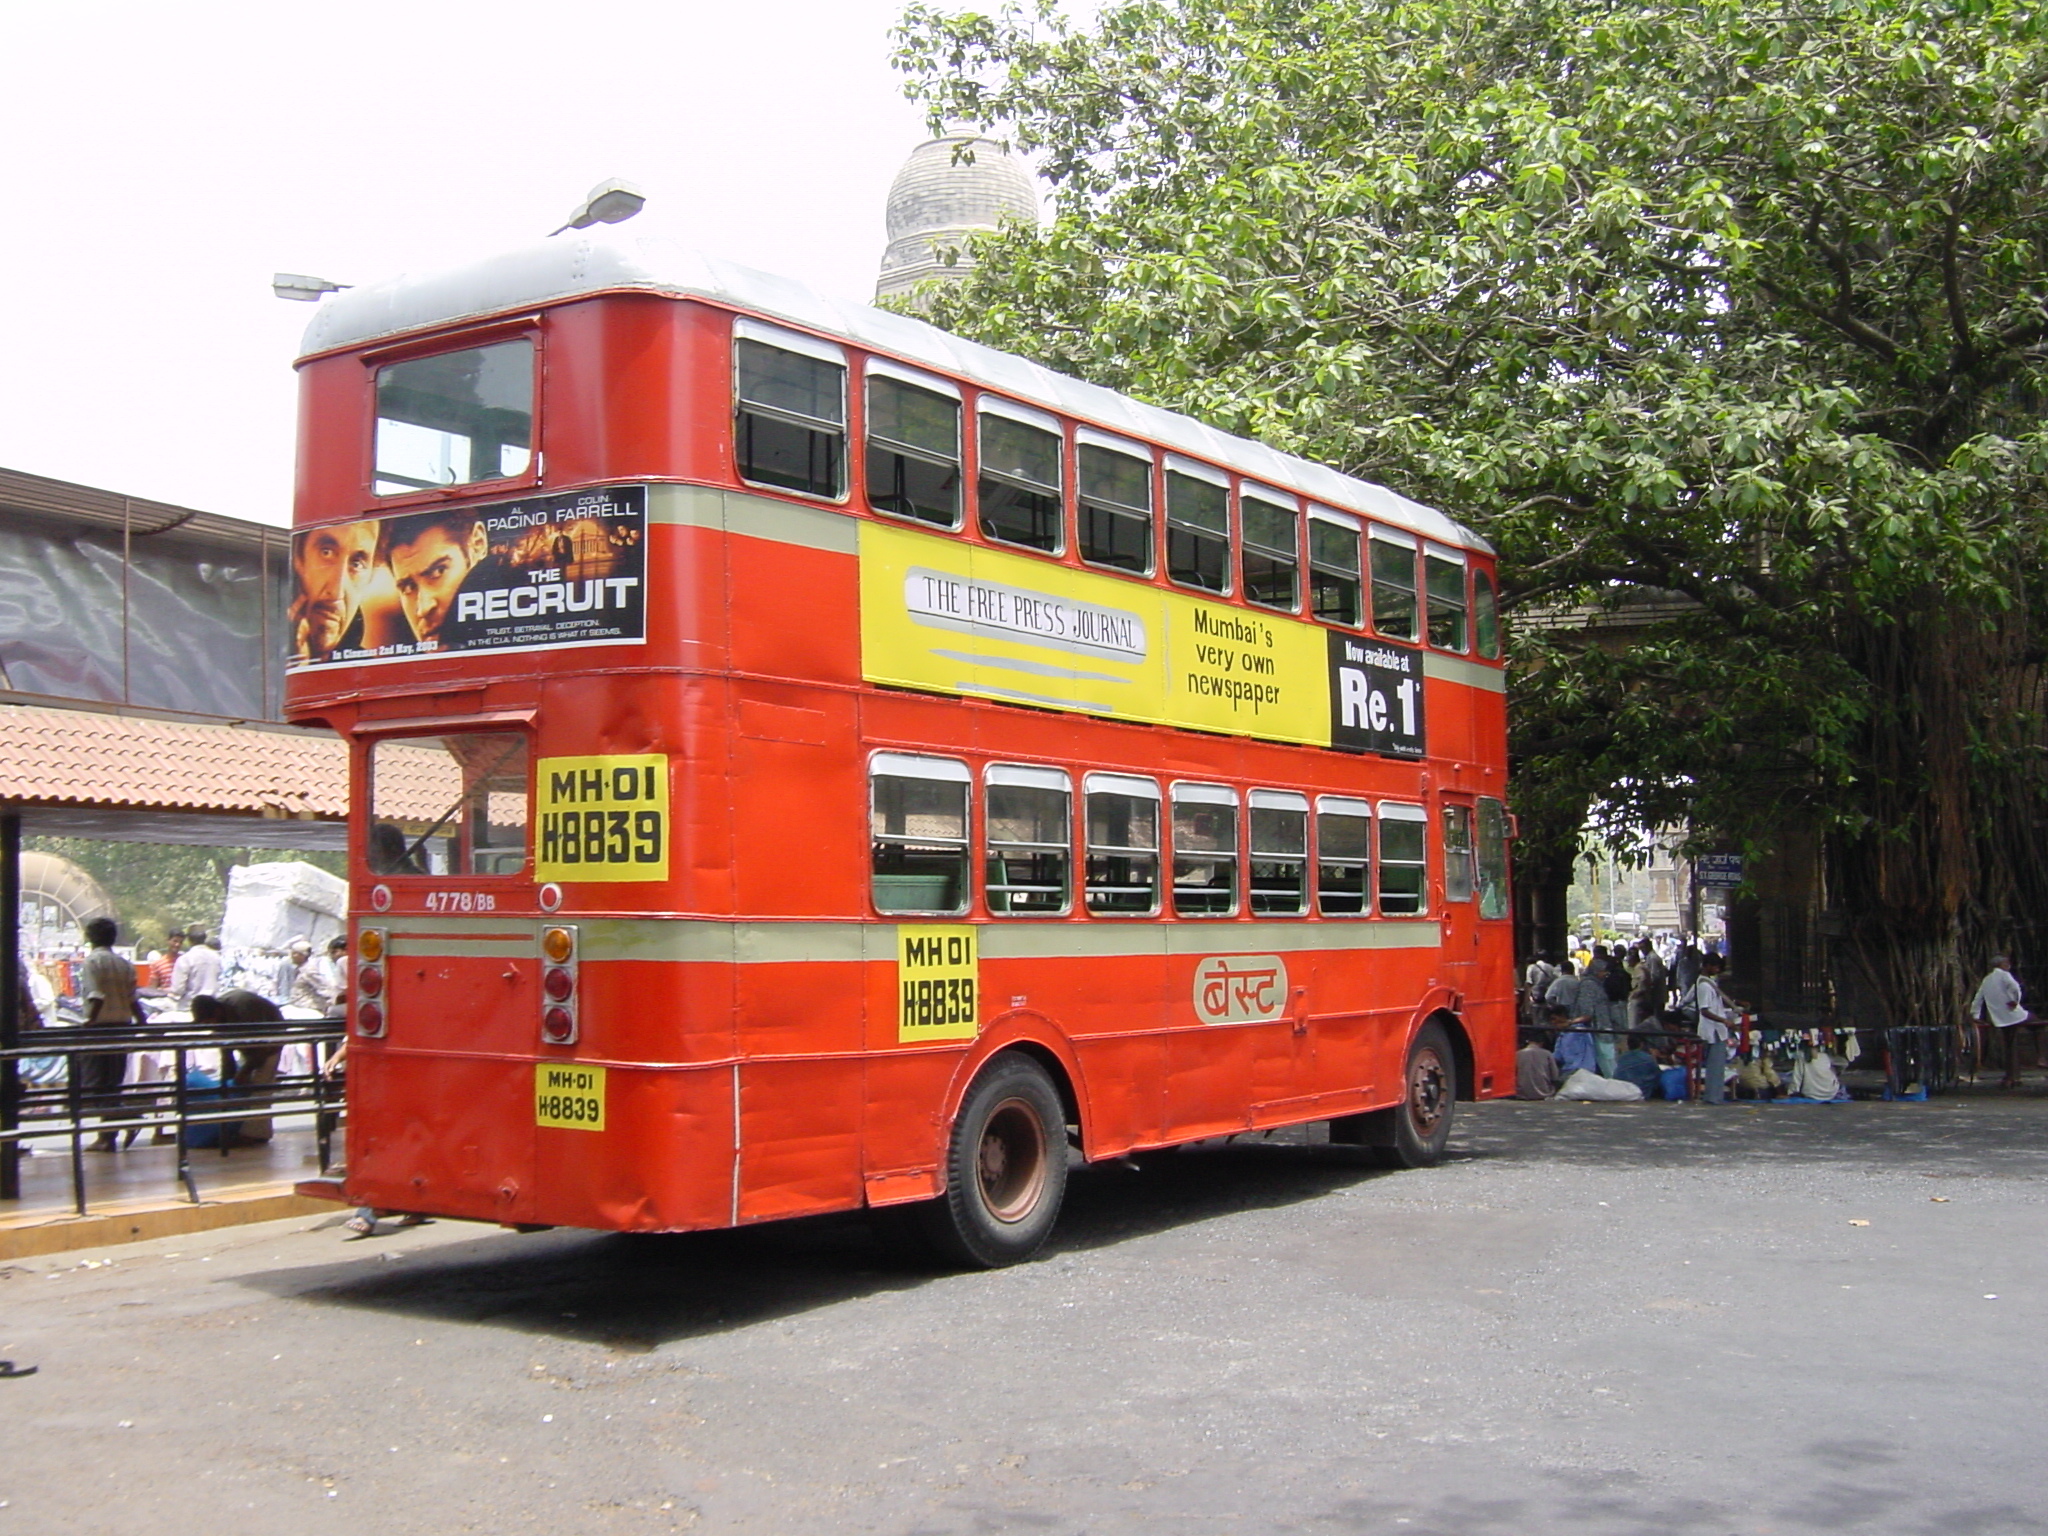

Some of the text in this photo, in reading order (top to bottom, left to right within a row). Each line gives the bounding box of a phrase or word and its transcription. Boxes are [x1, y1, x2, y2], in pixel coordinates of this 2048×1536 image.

[511, 507, 524, 515] AL
[556, 502, 638, 523] FARRELL
[578, 495, 609, 506] COLIN
[487, 512, 547, 531] PACINO
[528, 568, 561, 583] THE
[457, 577, 638, 623] RECRUIT
[923, 576, 1137, 649] THE FREE PRESS JOURNAL
[478, 637, 491, 645] THE
[512, 633, 548, 643] NOTHING
[549, 632, 556, 640] IS
[558, 630, 579, 639] WHAT
[580, 629, 588, 637] IT
[1194, 607, 1273, 648] Mumbai's
[1196, 644, 1275, 675] very own
[1345, 640, 1364, 663] Now
[1365, 647, 1399, 671] available
[1188, 673, 1280, 715] newspaper
[1203, 960, 1277, 1016] बेस्ट
